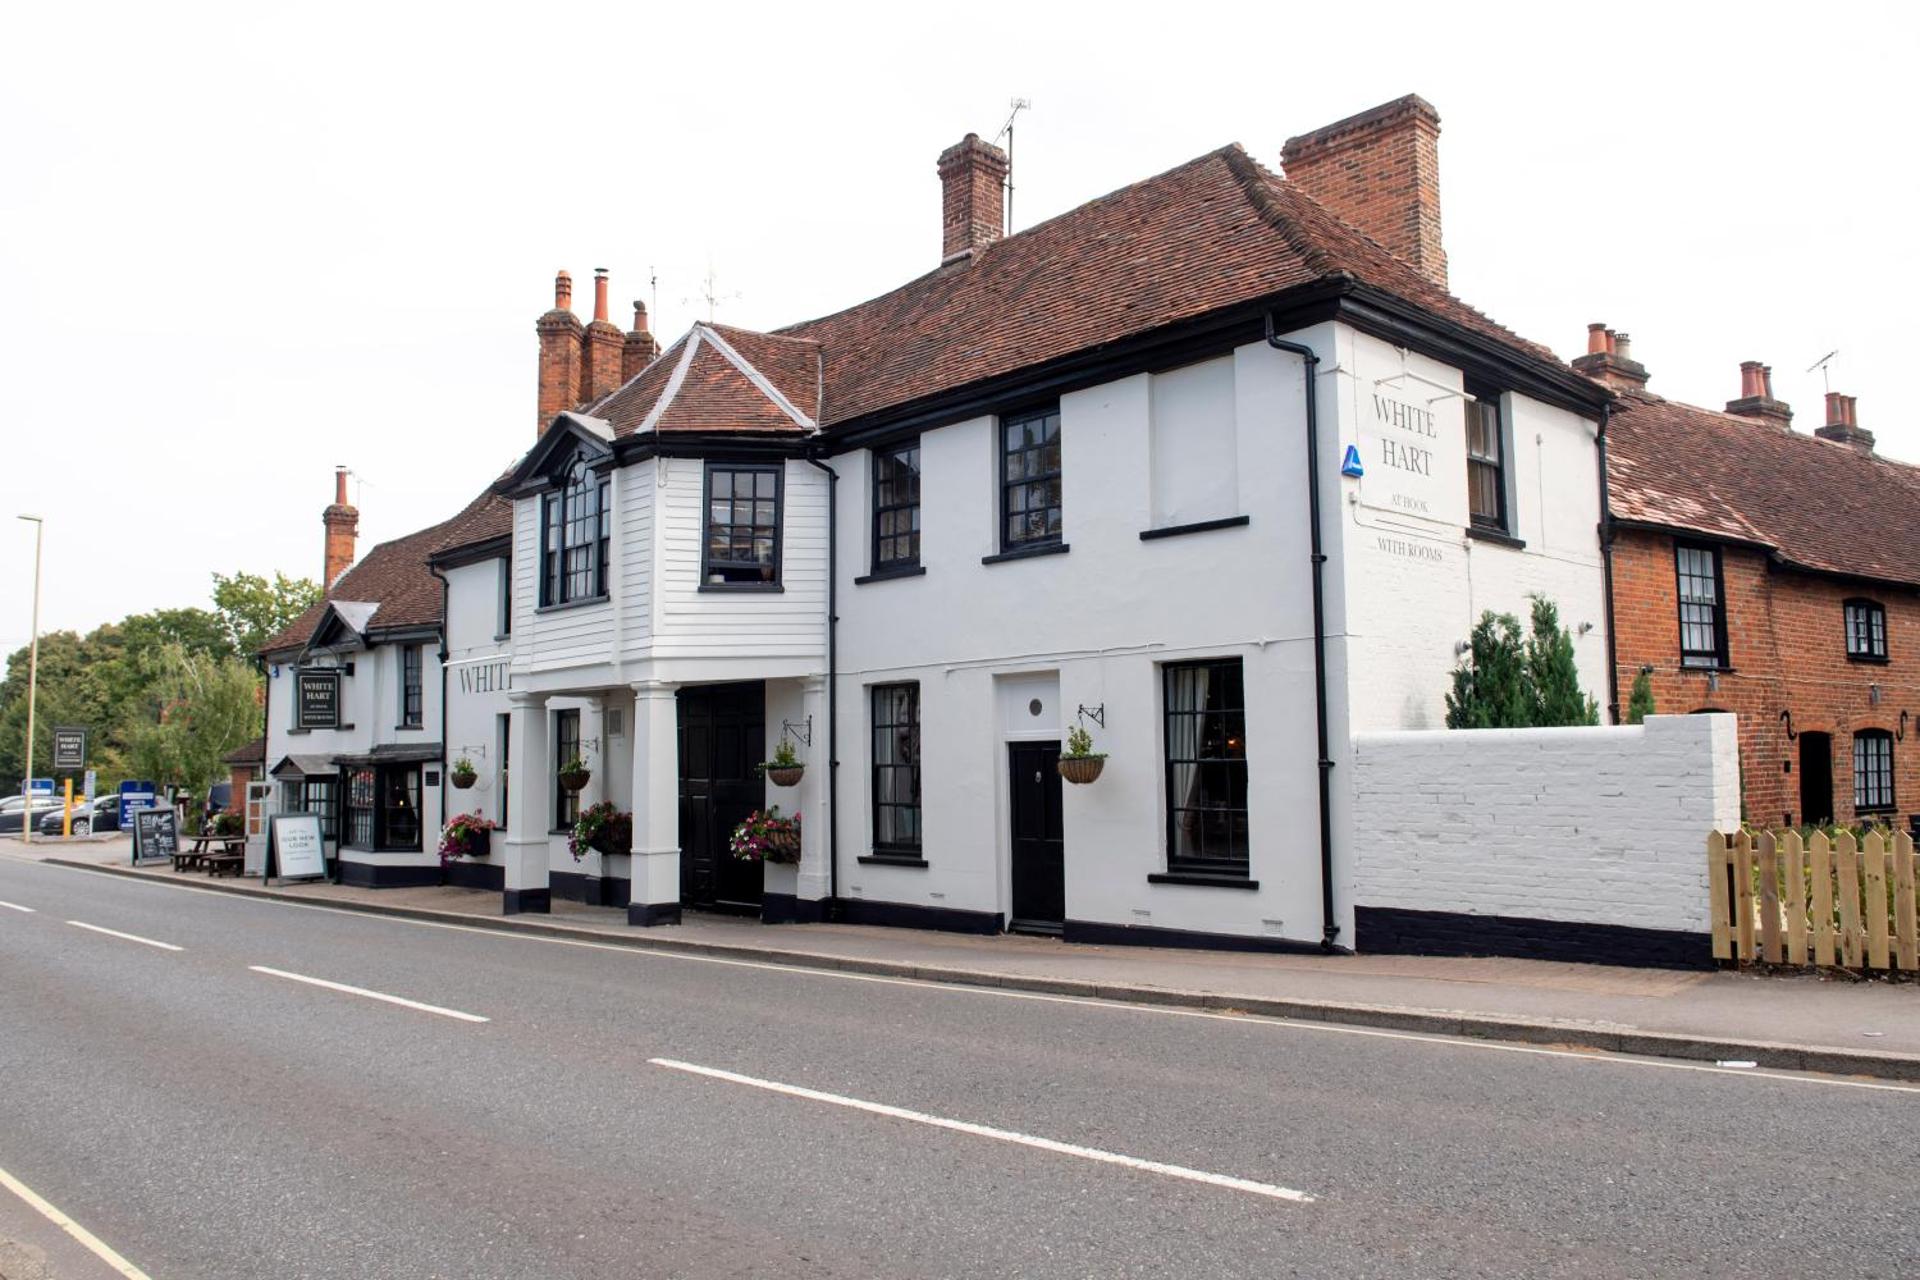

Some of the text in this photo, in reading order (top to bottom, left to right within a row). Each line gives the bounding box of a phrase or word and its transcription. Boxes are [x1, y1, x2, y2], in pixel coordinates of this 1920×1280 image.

[1373, 395, 1437, 438] WHITE
[1382, 438, 1433, 476] HART
[1402, 496, 1430, 513] HOOK
[1377, 537, 1443, 561] WITH ROOMS
[306, 692, 331, 700] HART
